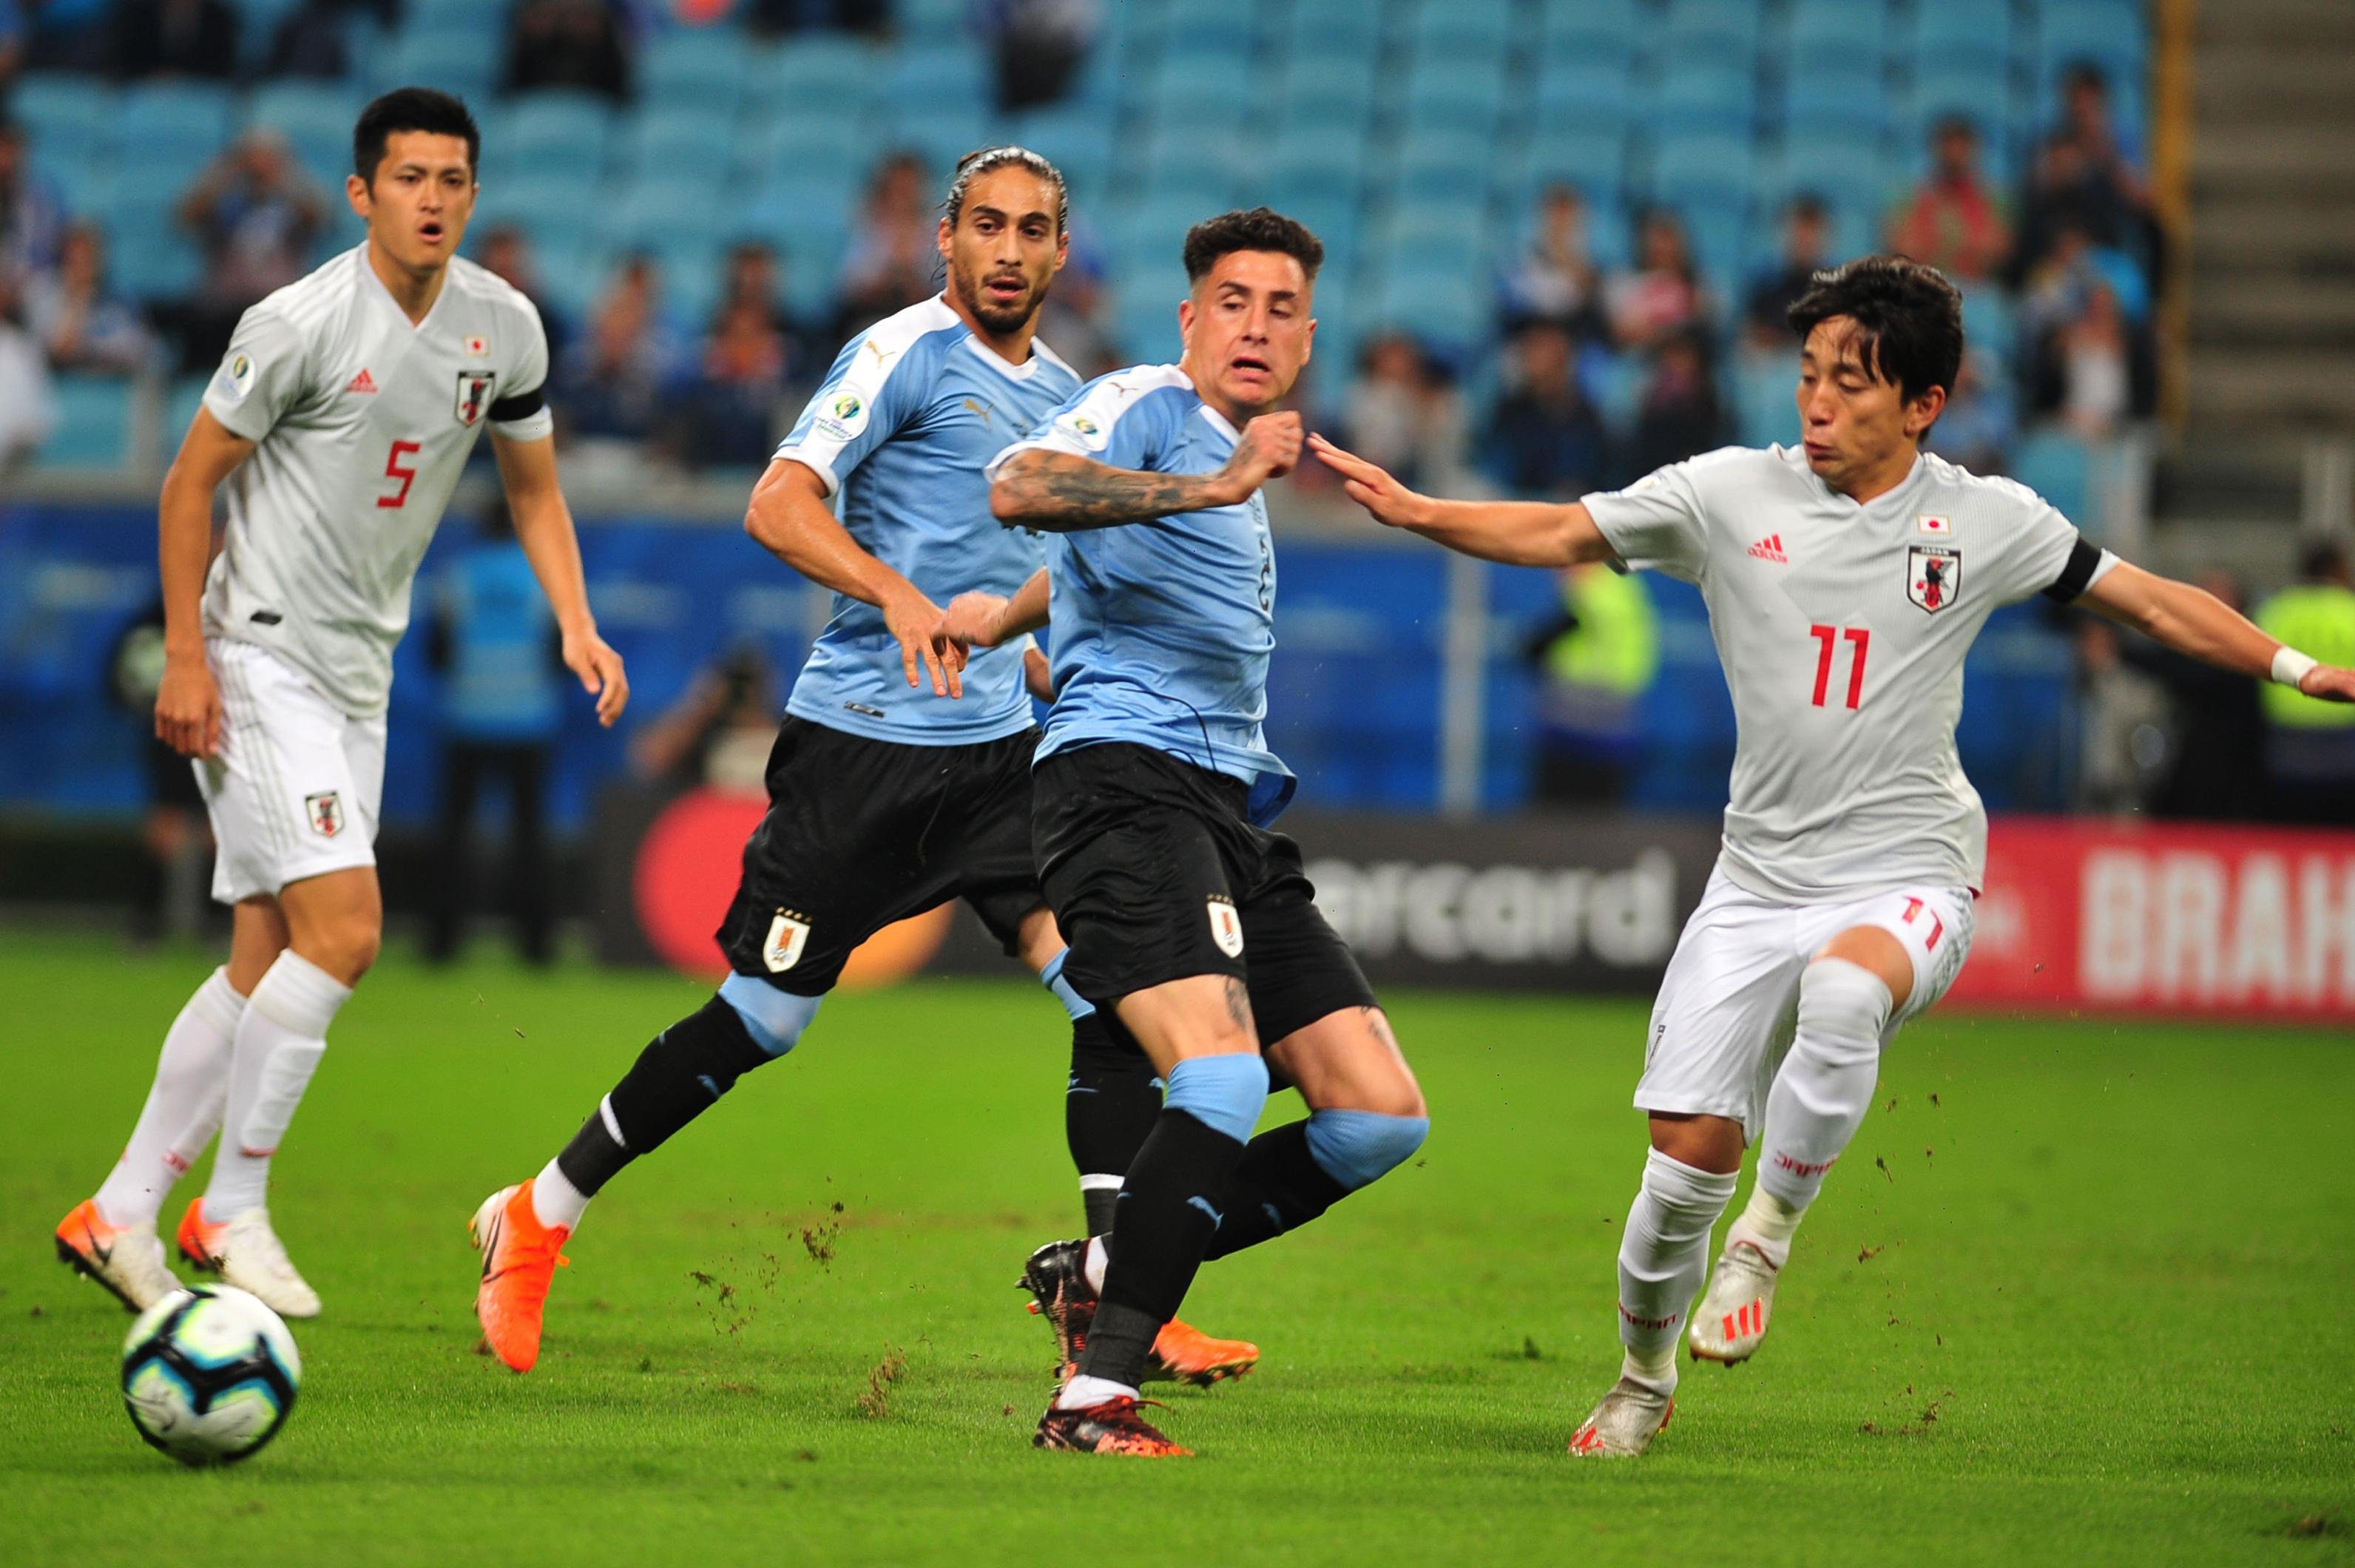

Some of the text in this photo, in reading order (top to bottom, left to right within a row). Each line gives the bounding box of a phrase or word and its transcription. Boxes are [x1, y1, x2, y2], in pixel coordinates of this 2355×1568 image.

[376, 439, 421, 509] 5
[1810, 624, 1870, 710] 11
[1902, 896, 1943, 953] 11
